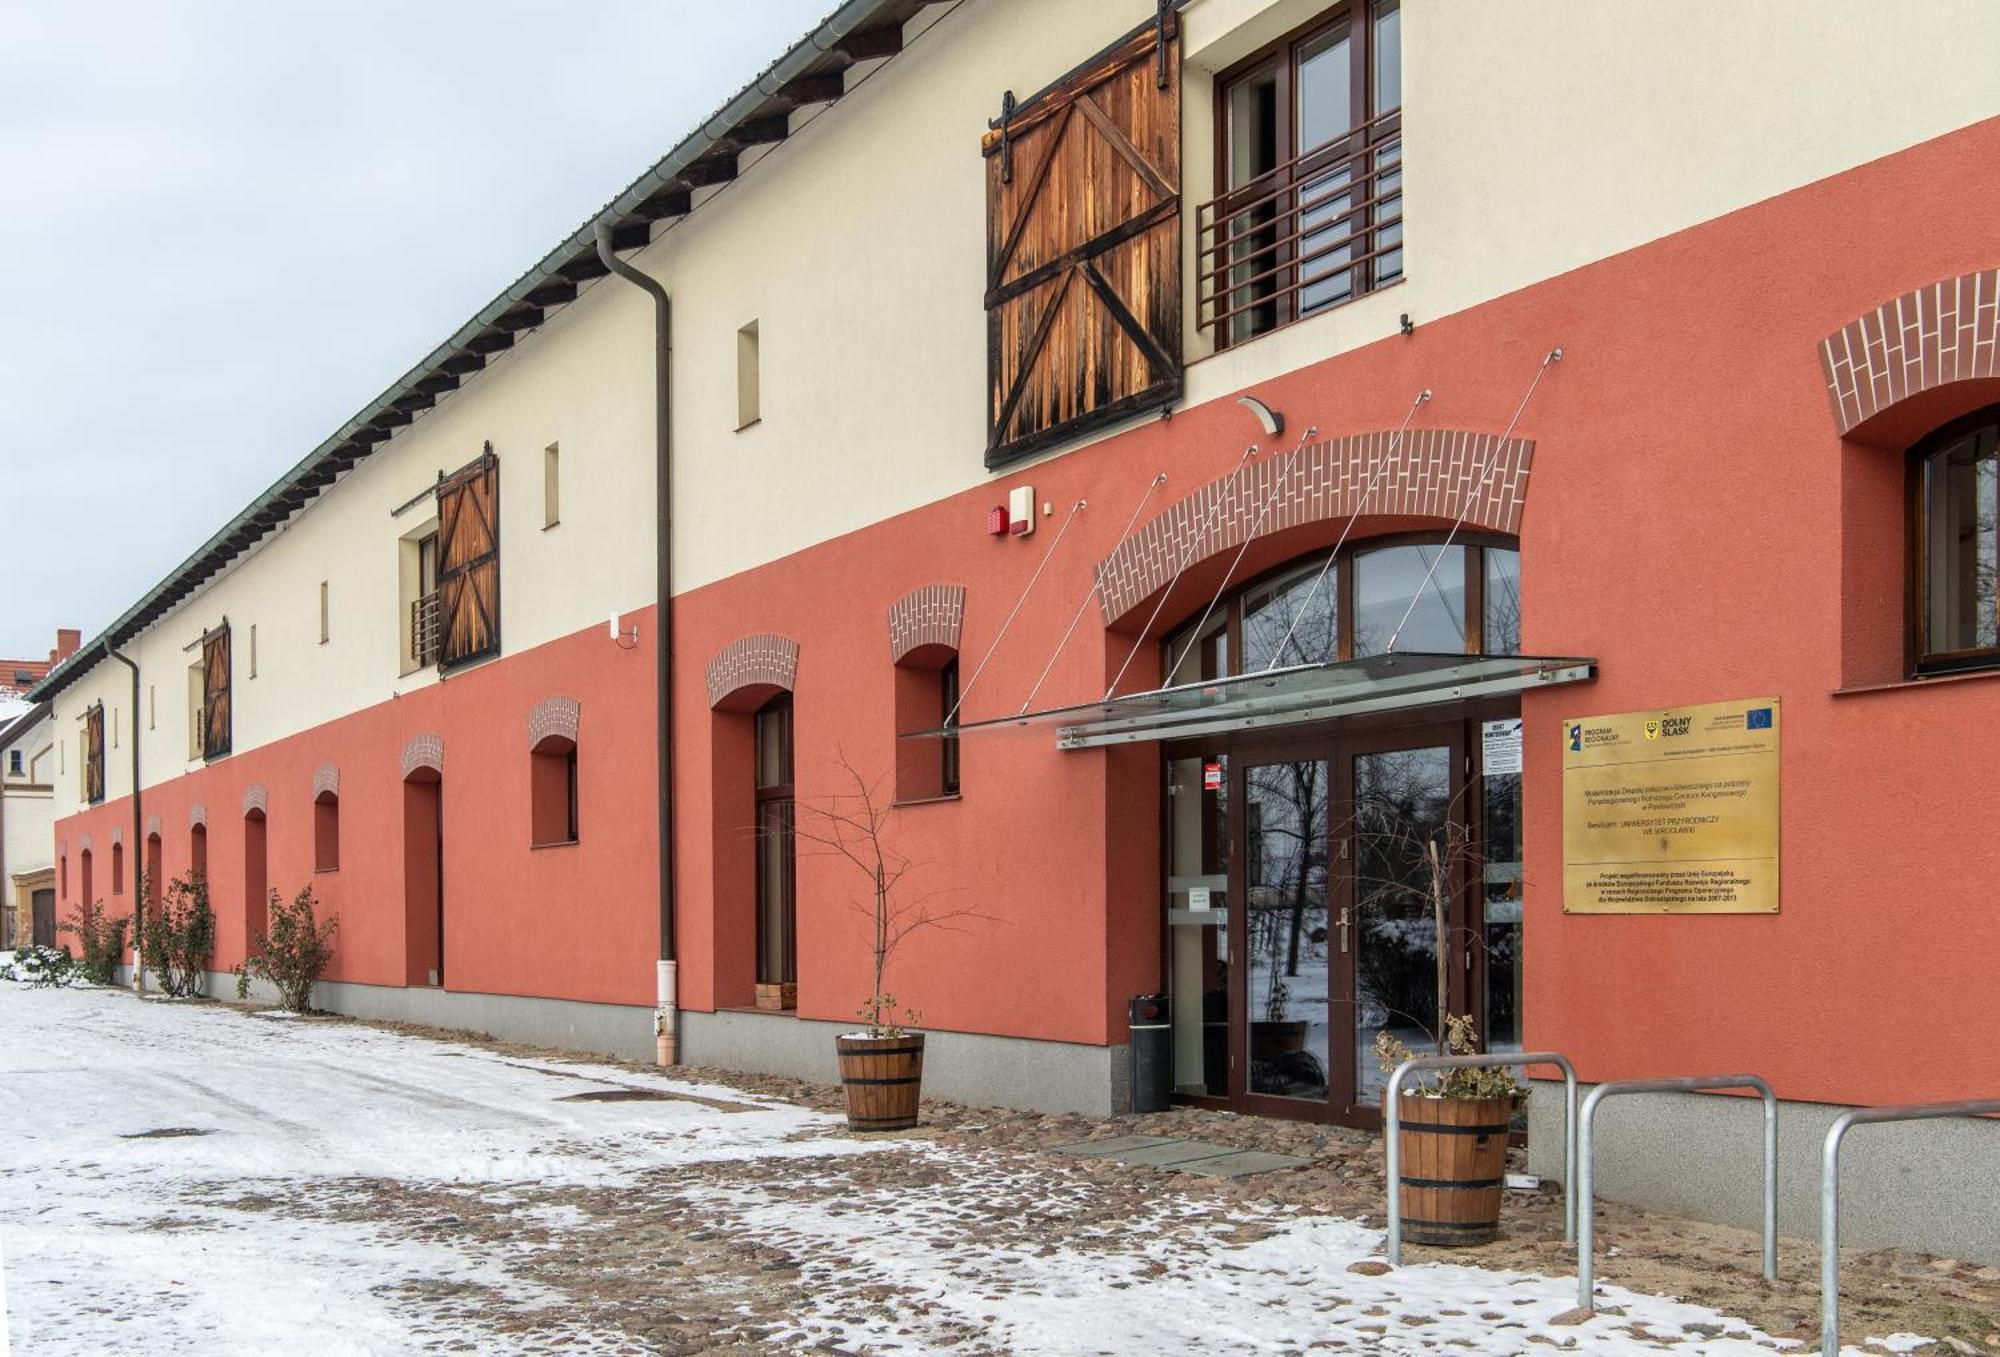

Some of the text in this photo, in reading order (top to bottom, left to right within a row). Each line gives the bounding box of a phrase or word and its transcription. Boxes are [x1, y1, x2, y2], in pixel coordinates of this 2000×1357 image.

[1662, 717, 1692, 727] DOLNY
[1621, 818, 1667, 827] UNIWERSYTET
[1667, 815, 1719, 825] PRZYRODNICZY
